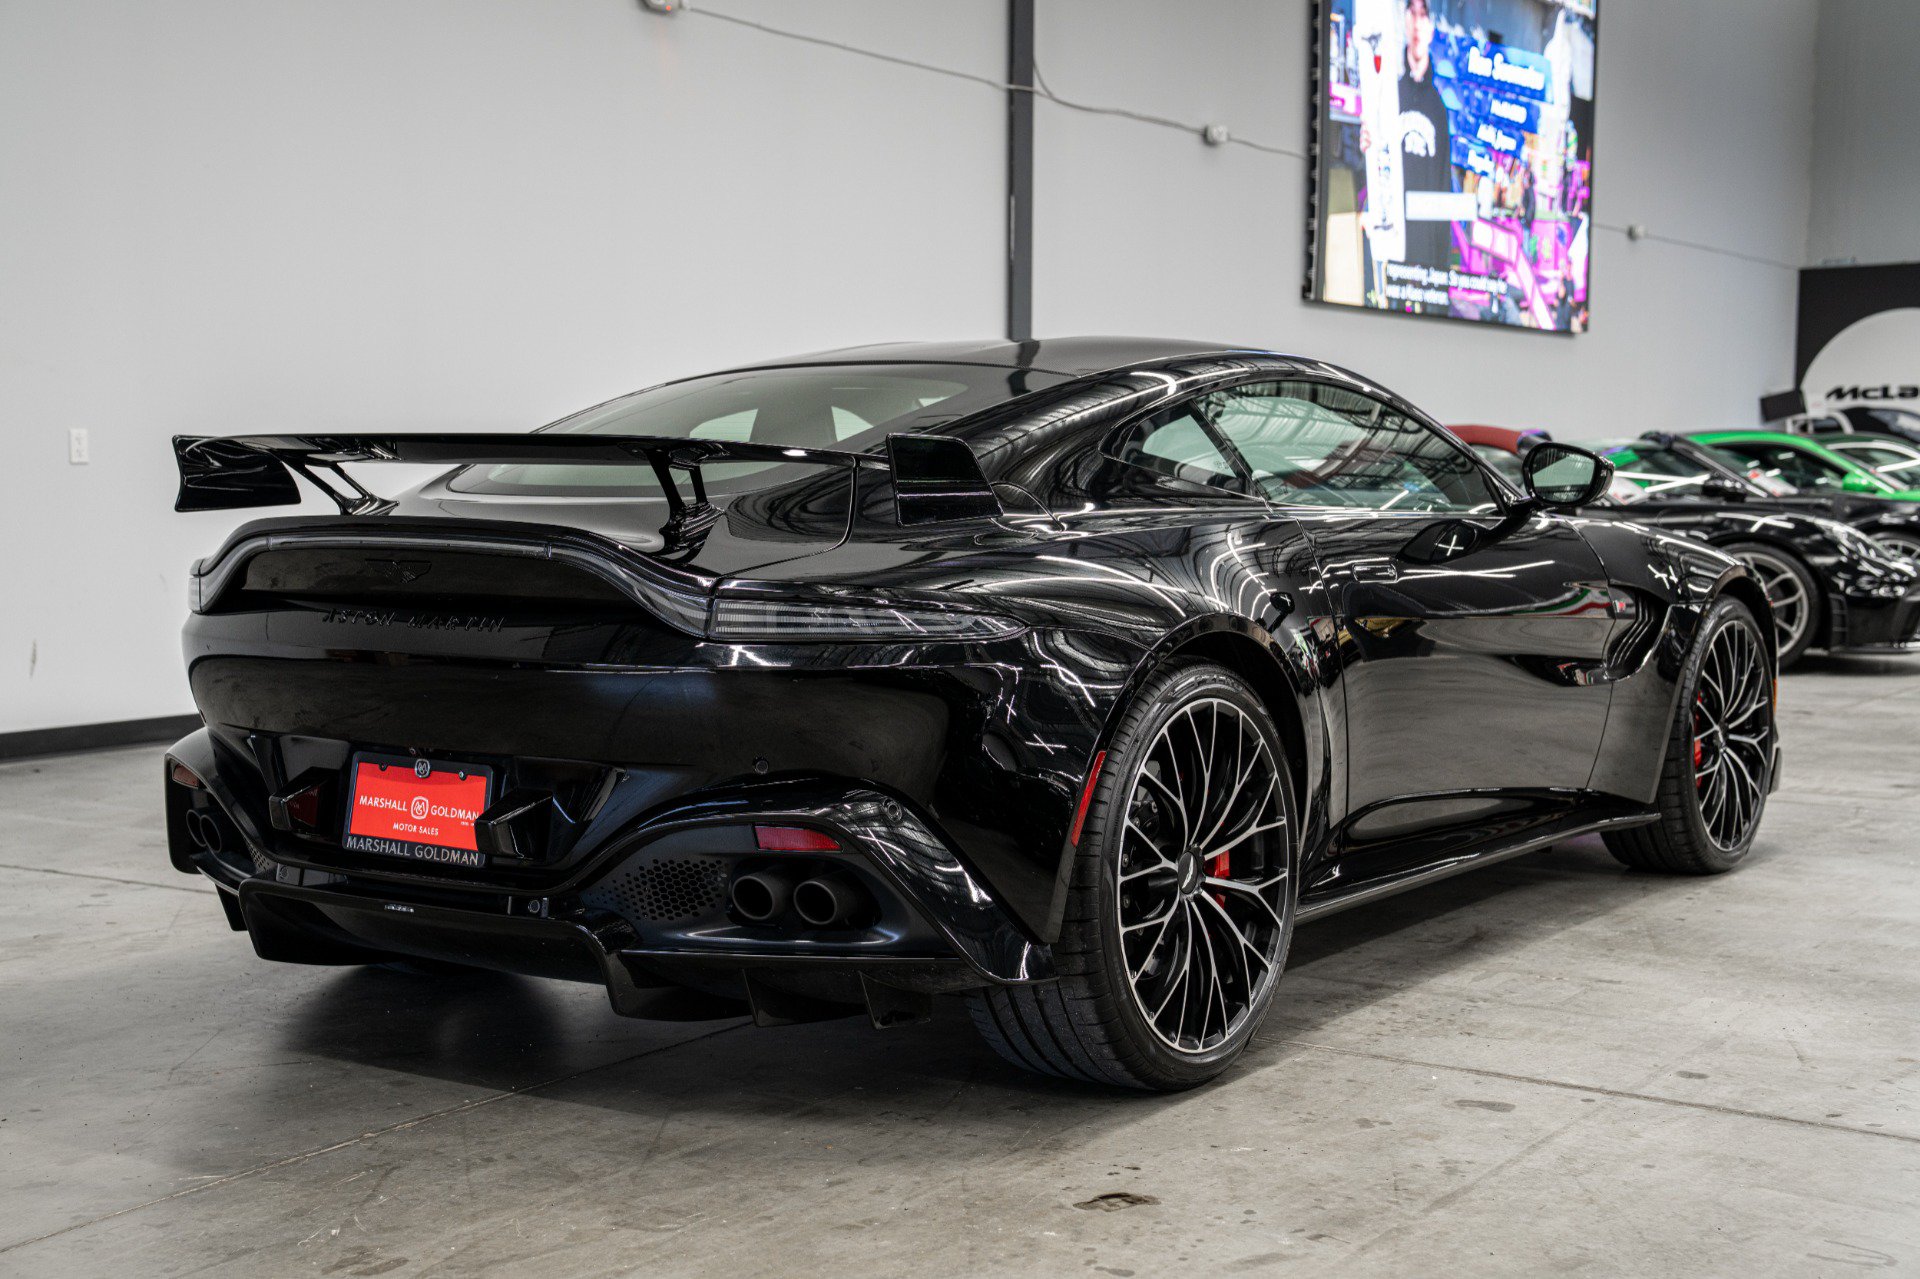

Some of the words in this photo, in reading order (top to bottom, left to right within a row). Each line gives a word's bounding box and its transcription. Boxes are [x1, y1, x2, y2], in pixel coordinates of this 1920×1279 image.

[323, 607, 395, 625] ASTON
[407, 614, 505, 633] MARTIN
[359, 795, 407, 812] MARSHALL
[431, 805, 479, 821] GOLDMAN
[392, 822, 417, 833] MOTOR
[418, 825, 439, 836] SALES
[346, 836, 411, 857] MARSHALL
[415, 845, 479, 866] GOLDMAN
